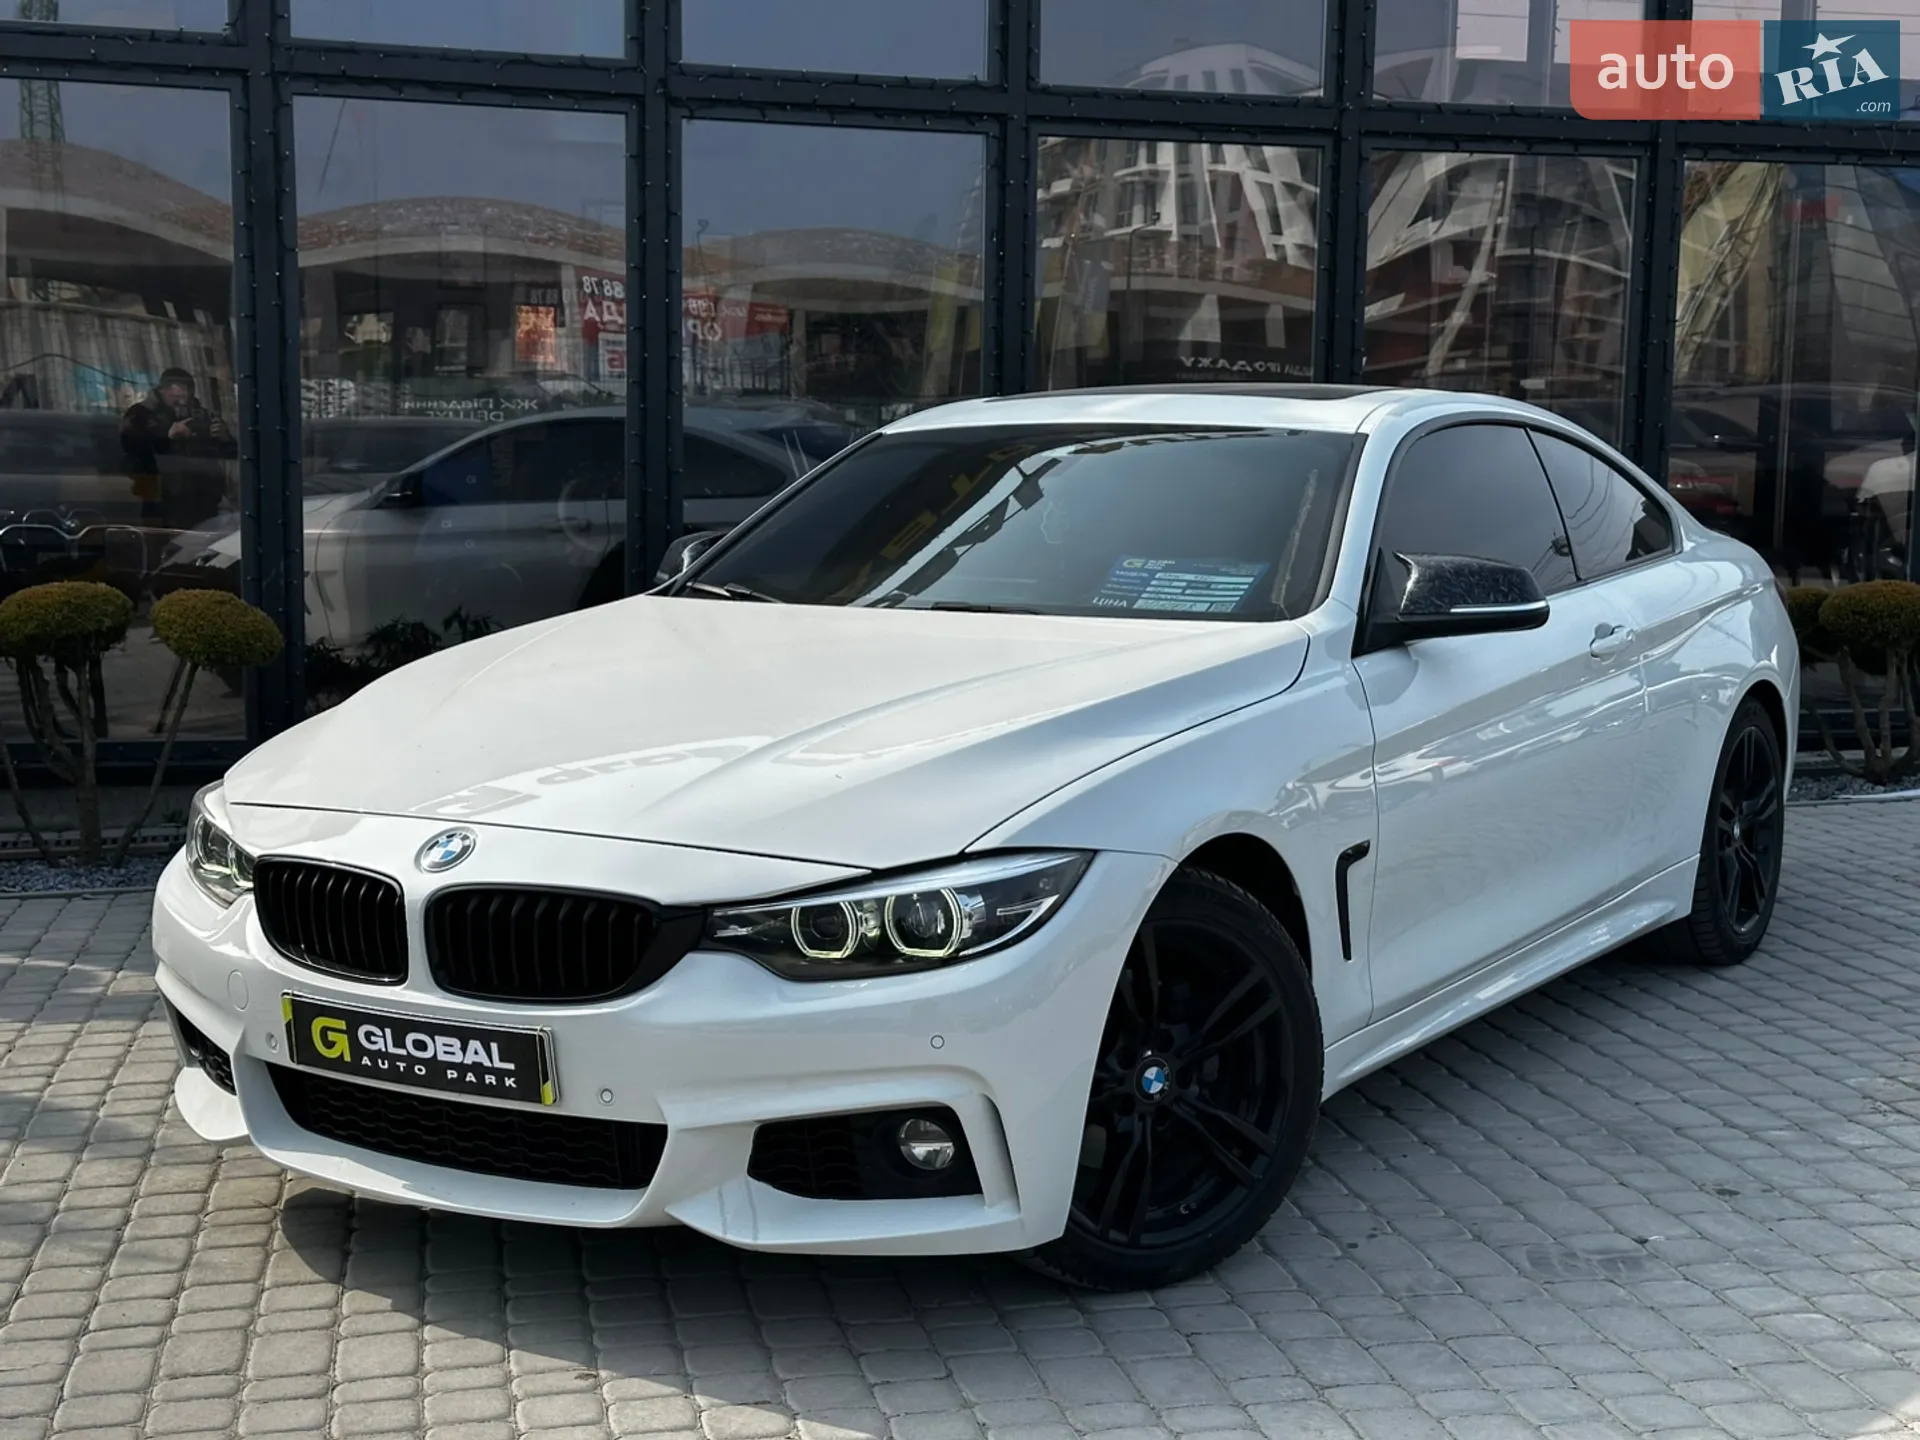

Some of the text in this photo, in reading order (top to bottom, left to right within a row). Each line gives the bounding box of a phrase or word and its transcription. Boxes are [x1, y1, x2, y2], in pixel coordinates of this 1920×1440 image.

[357, 1023, 515, 1070] GLOBAL
[360, 1055, 518, 1088] AUTO PARK
